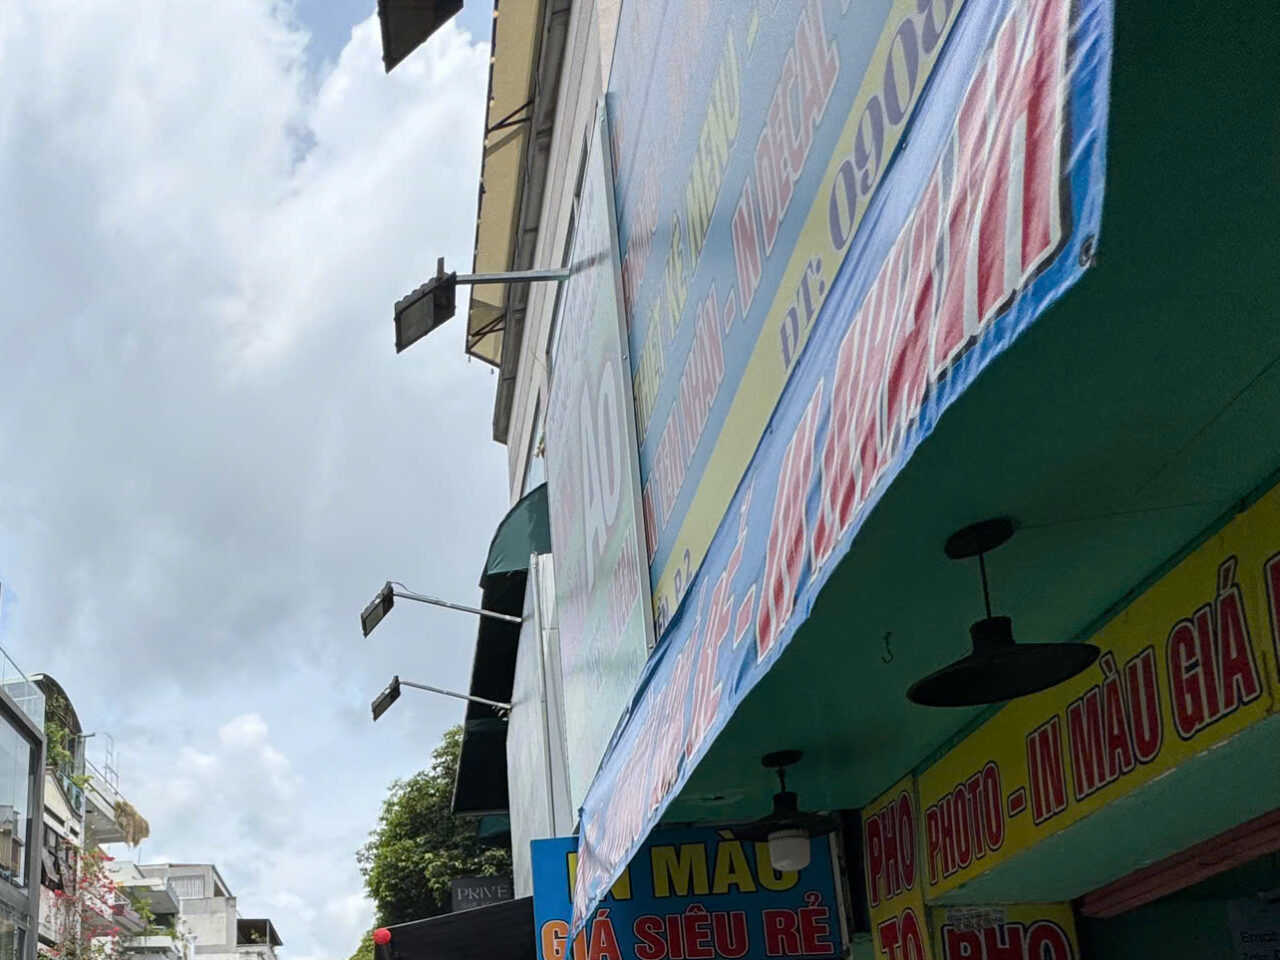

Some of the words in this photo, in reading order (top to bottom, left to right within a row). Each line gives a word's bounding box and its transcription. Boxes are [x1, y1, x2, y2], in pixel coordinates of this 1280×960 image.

[731, 170, 762, 320] IN
[754, 0, 840, 257] DECAL
[924, 760, 1006, 886] PHOTO
[1026, 714, 1067, 827] IN
[1065, 644, 1162, 801] MÀU
[1166, 554, 1264, 743] GIÁ
[650, 829, 801, 896] MÀU
[864, 790, 919, 908] PHO
[762, 890, 835, 957] RẺ
